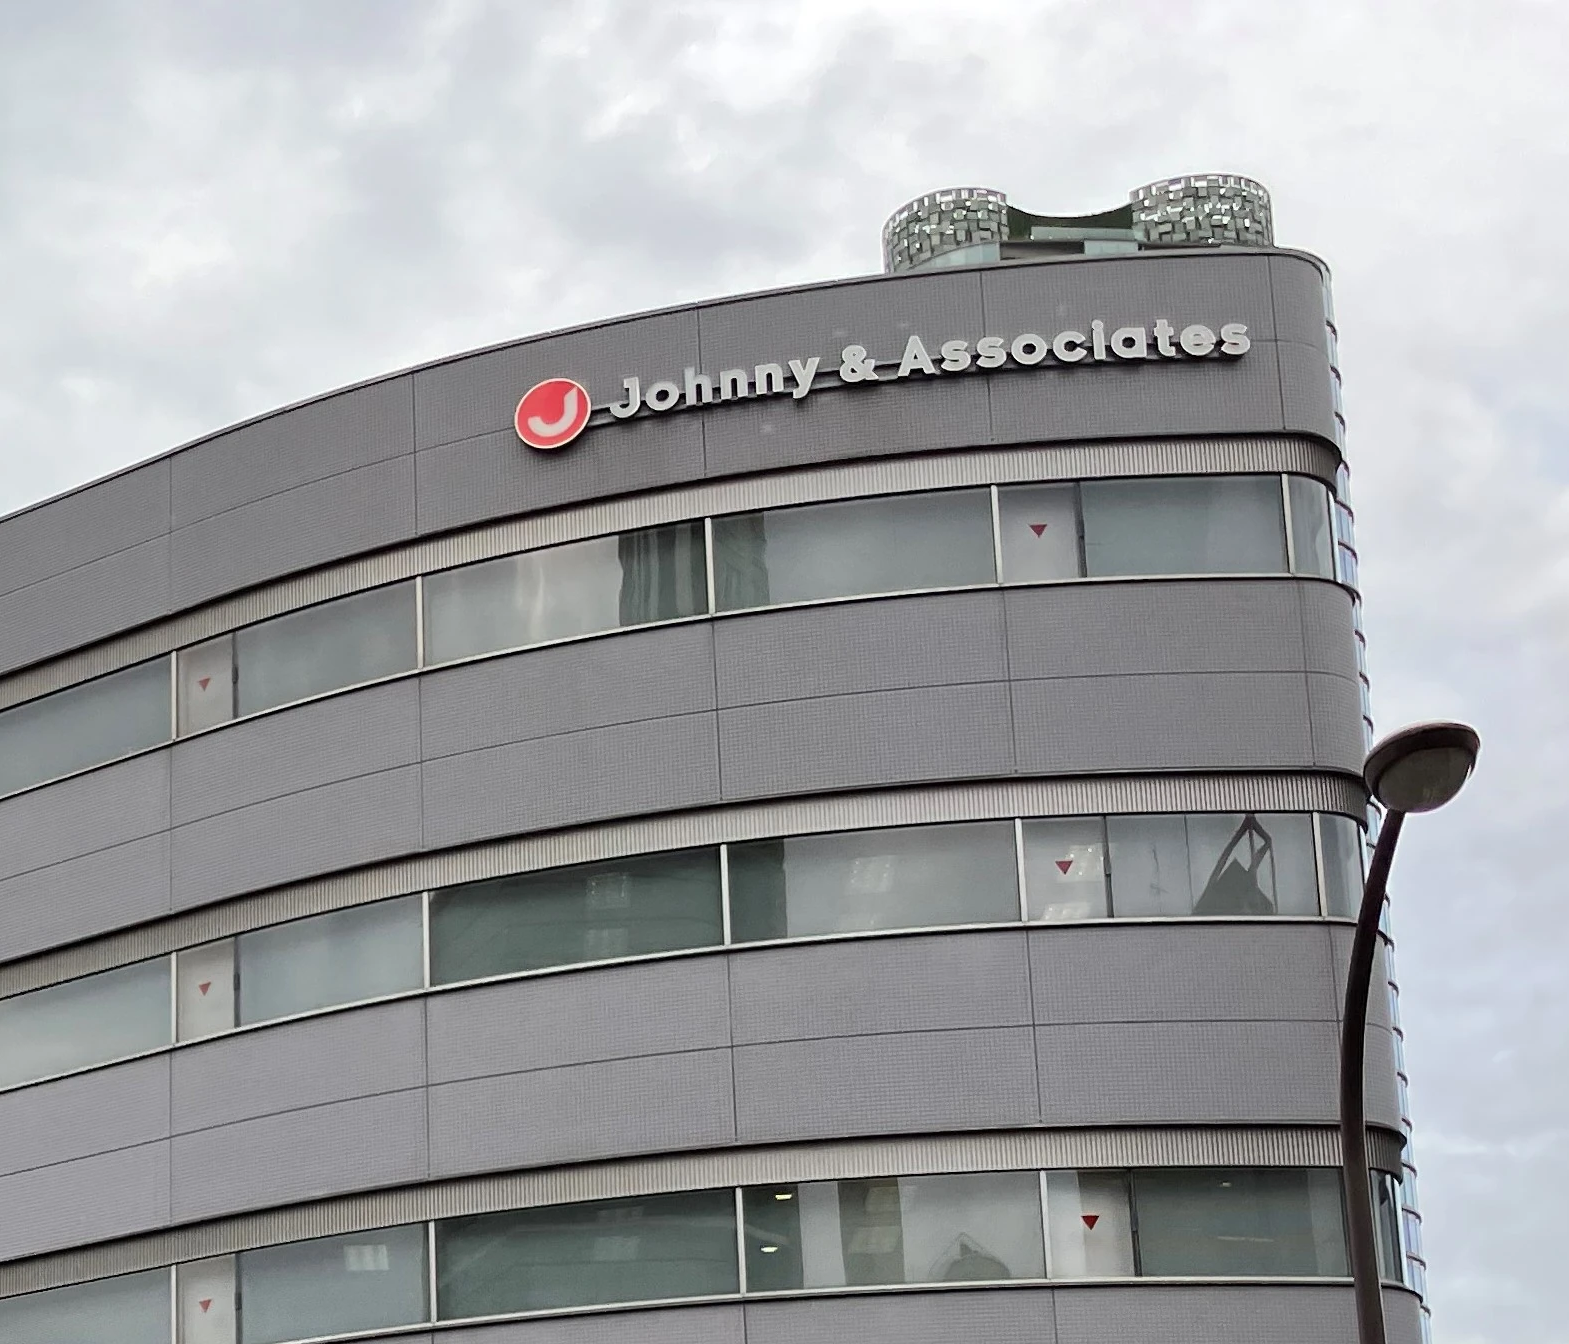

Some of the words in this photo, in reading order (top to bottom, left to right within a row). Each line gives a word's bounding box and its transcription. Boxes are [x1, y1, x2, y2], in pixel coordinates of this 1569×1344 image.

[609, 356, 821, 419] Johnny
[839, 344, 879, 383] &
[897, 318, 1251, 377] Associates
